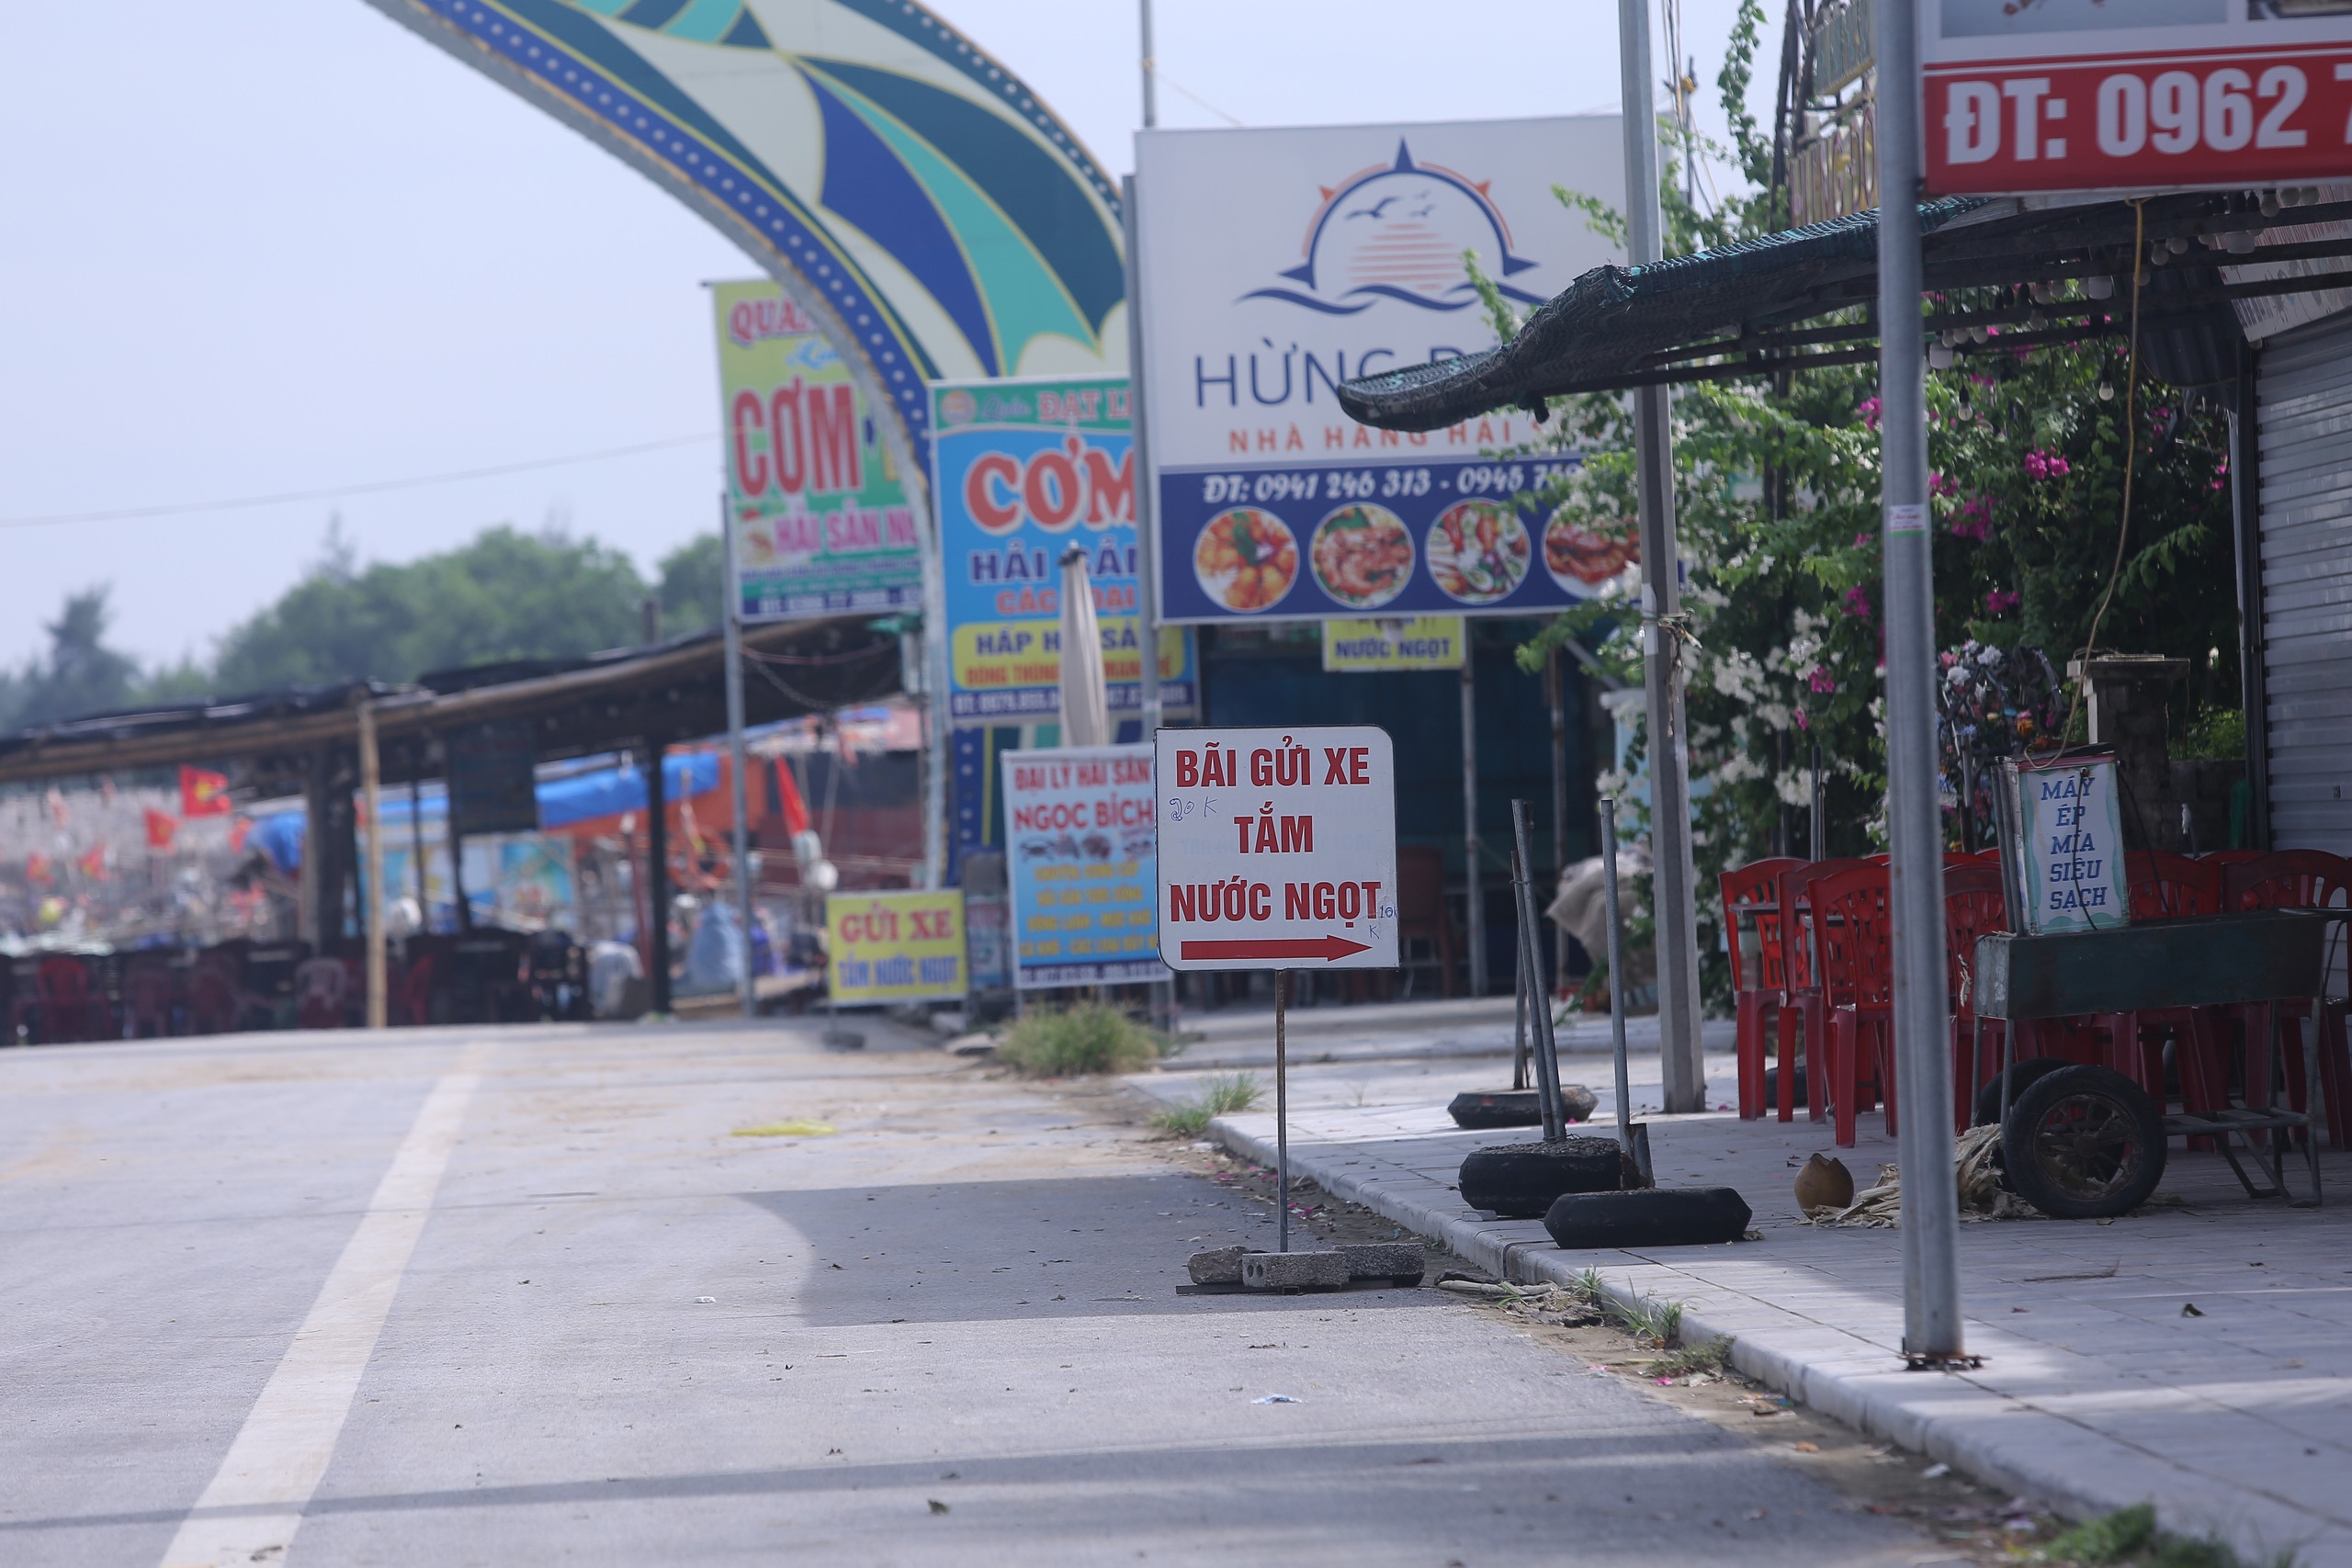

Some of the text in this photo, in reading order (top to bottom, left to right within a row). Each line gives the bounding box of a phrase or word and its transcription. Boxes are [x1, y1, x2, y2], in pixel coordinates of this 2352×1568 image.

[1944, 77, 2067, 165] ĐT:
[2097, 65, 2308, 158] 0962
[732, 376, 863, 497] CƠM
[1230, 418, 1305, 453] NHÀ
[1254, 472, 1319, 502] 0941
[1382, 468, 1431, 498] 313
[969, 538, 1048, 584] HẢI
[995, 585, 1057, 616] CÁC
[1101, 620, 1139, 649] SẢ
[1175, 735, 1370, 787] BÃI GỬI XE
[2041, 775, 2096, 801] MÁY
[1014, 802, 1089, 839] NGỌC
[1233, 801, 1314, 854] TẮM
[2056, 804, 2086, 827] ÉP
[2051, 829, 2096, 855] MÍA
[2050, 857, 2103, 882] SIÊU
[1170, 874, 1272, 922] NƯỚC
[1284, 881, 1382, 929] NGỌT
[2050, 886, 2109, 912] SẠCH
[910, 908, 955, 942] XE
